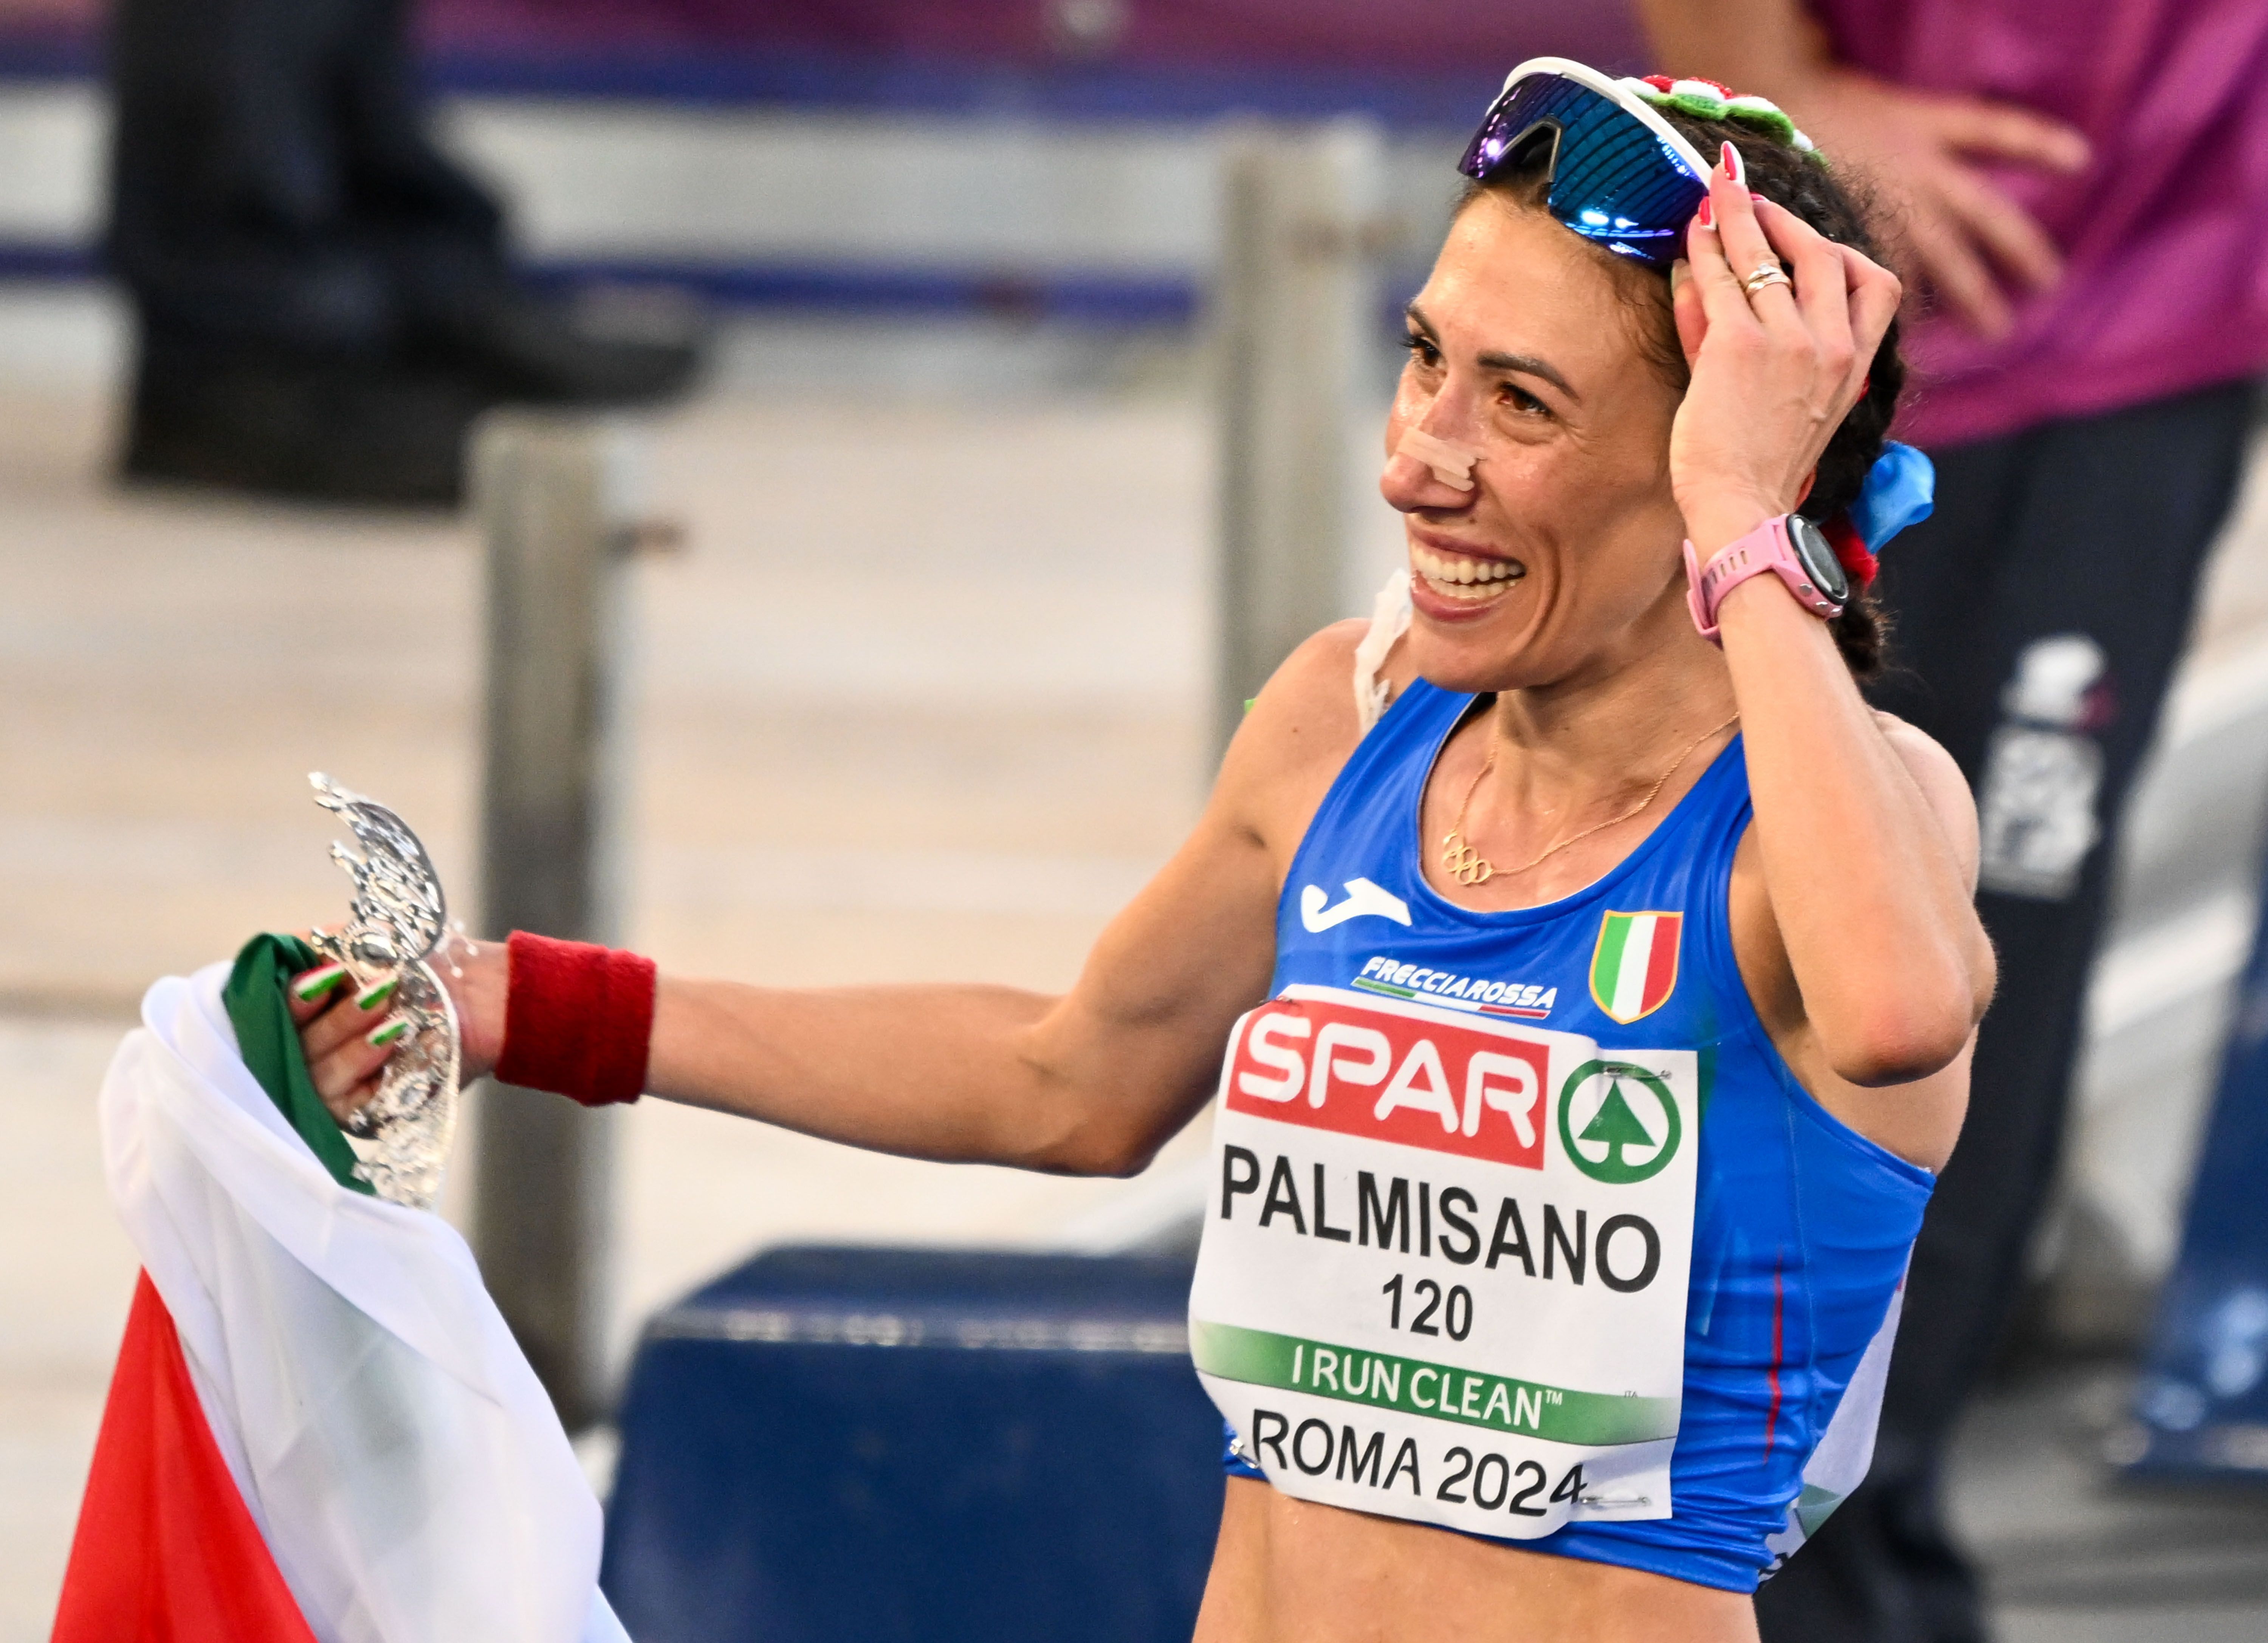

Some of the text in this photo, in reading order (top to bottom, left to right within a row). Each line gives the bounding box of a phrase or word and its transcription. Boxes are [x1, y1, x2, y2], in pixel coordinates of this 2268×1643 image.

[1361, 956, 1558, 1009] FRECCIAROSSA
[1238, 1010, 1539, 1149] SPAR
[1220, 1144, 1661, 1293] PALMISANO
[1382, 1274, 1473, 1341] 120
[1292, 1344, 1303, 1384] I
[1312, 1349, 1401, 1403] RUN
[1252, 1408, 1587, 1517] ROMA 2024
